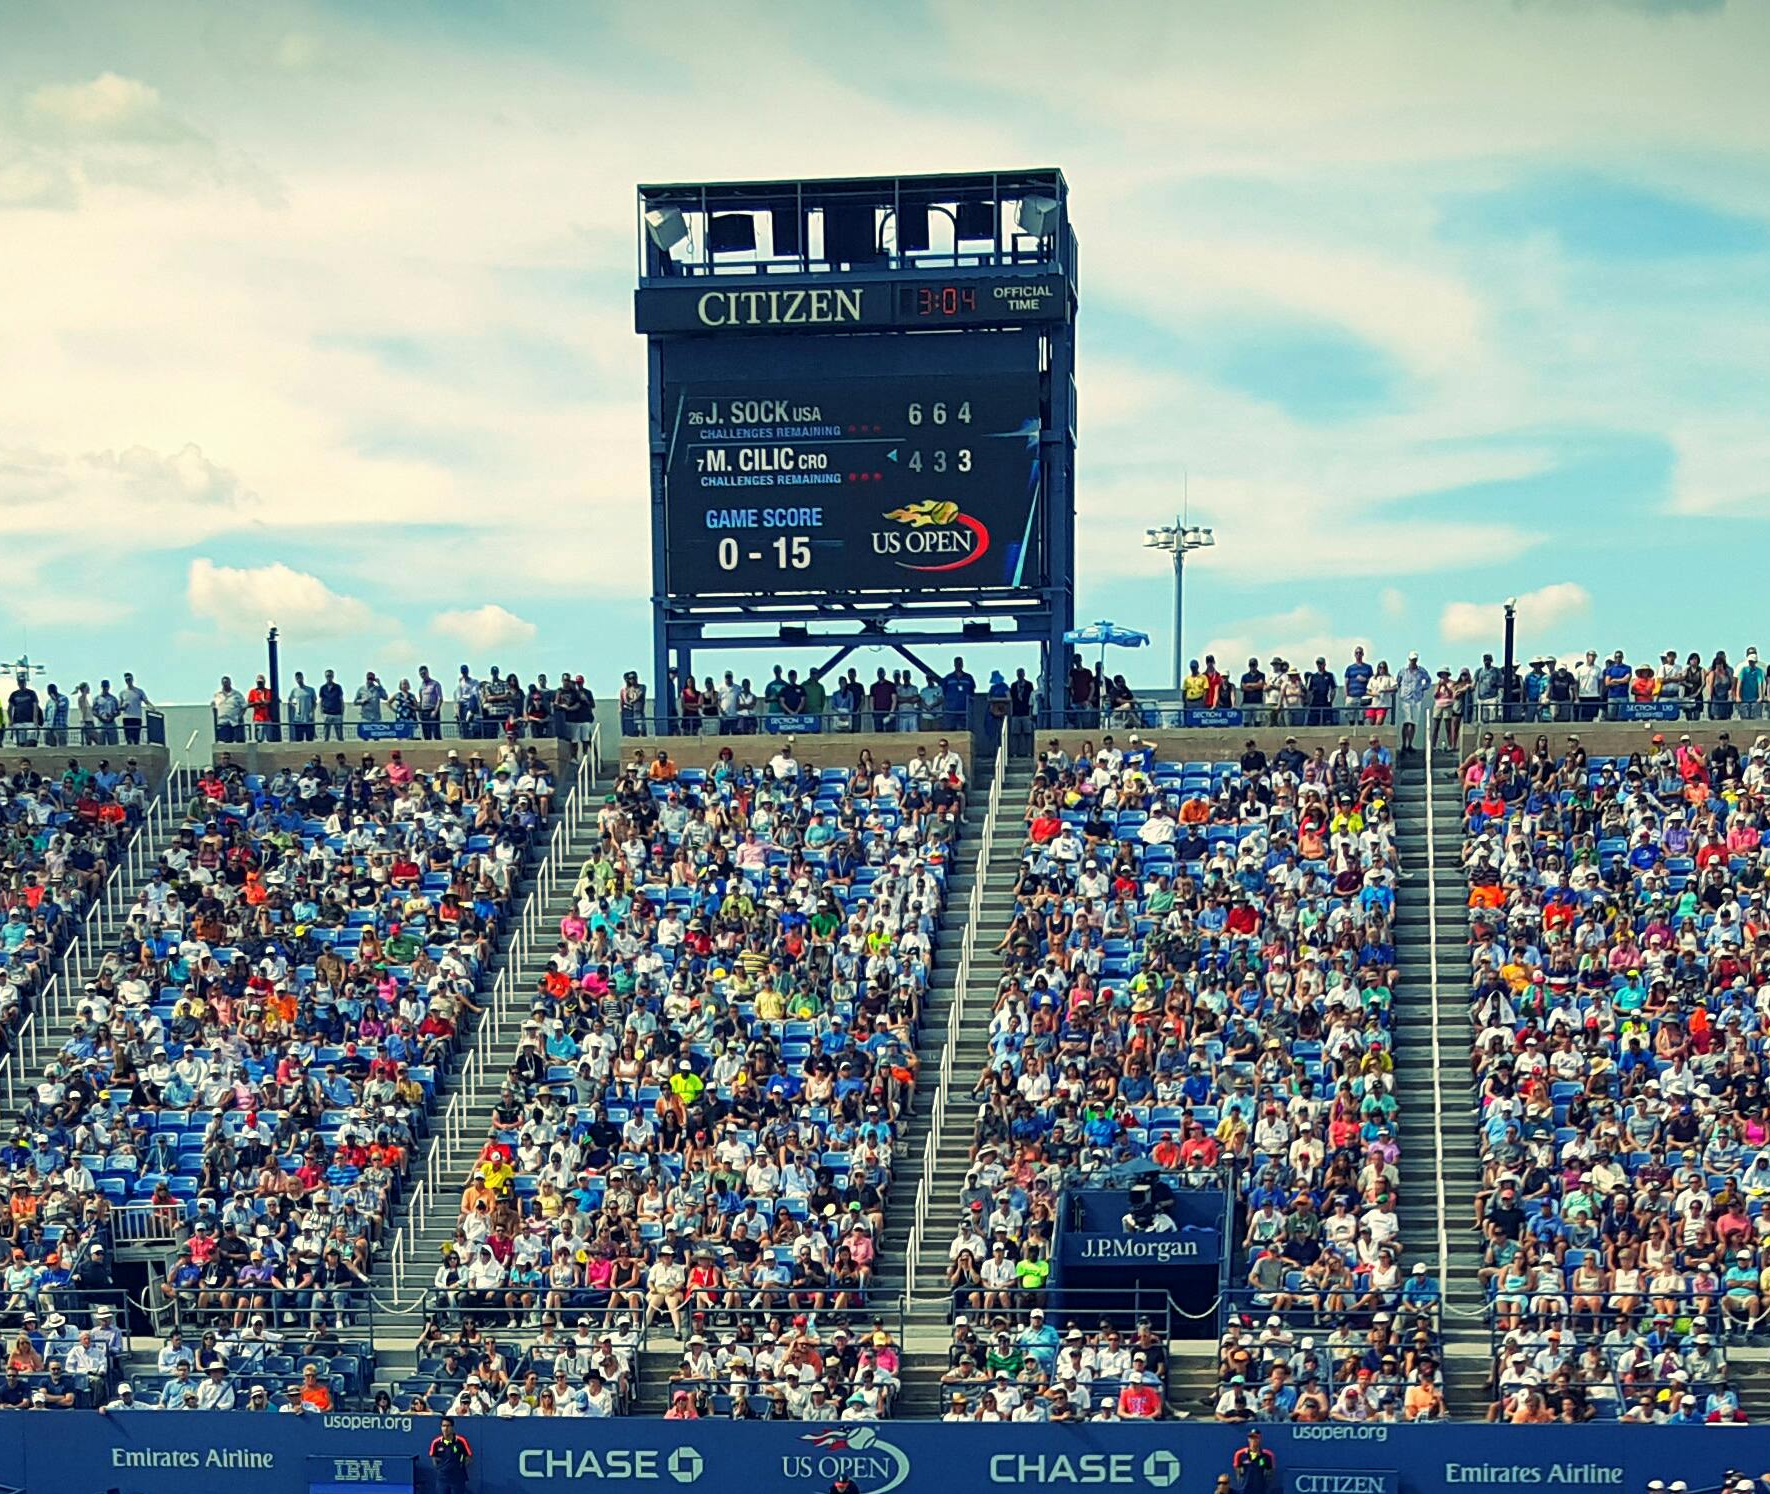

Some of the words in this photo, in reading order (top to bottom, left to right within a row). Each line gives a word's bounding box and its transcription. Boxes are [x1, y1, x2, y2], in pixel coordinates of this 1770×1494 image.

[919, 287, 976, 315] 3:04
[993, 285, 1054, 299] OFFICIAL
[697, 288, 864, 327] CITIZEN
[1007, 299, 1041, 312] TIME
[730, 400, 790, 424] SOCK
[793, 406, 822, 422] USA
[908, 402, 923, 425] 6
[933, 402, 947, 425] 6
[957, 401, 972, 424] 4
[700, 427, 773, 439] CHALLENGES
[776, 425, 841, 438] REMAINING
[739, 447, 795, 471] CILIC
[798, 453, 828, 470] CRO
[908, 450, 923, 473] 4
[933, 450, 947, 473] 3
[958, 449, 972, 472] 3
[701, 475, 774, 487] CHALLENGES
[777, 473, 842, 485] REMAINING
[706, 508, 758, 528] GAME
[762, 507, 823, 527] SCORE
[718, 537, 739, 570] 0
[773, 536, 812, 569] 15
[872, 531, 901, 554] US
[904, 530, 974, 553] OPEN
[1081, 1239, 1198, 1262] J.P.Morgan
[323, 1415, 413, 1432] usopen.org
[1292, 1426, 1388, 1441] usopen.org
[111, 1447, 199, 1467] Emirates
[205, 1448, 274, 1468] Airline
[519, 1449, 660, 1478] CHASE
[781, 1456, 812, 1478] US
[818, 1456, 890, 1479] OPEN
[990, 1454, 1135, 1483] CHASE
[333, 1459, 384, 1481] IBM
[1445, 1463, 1542, 1483] Emirates
[1546, 1463, 1624, 1484] Airline
[1295, 1474, 1387, 1494] CITIZEN
